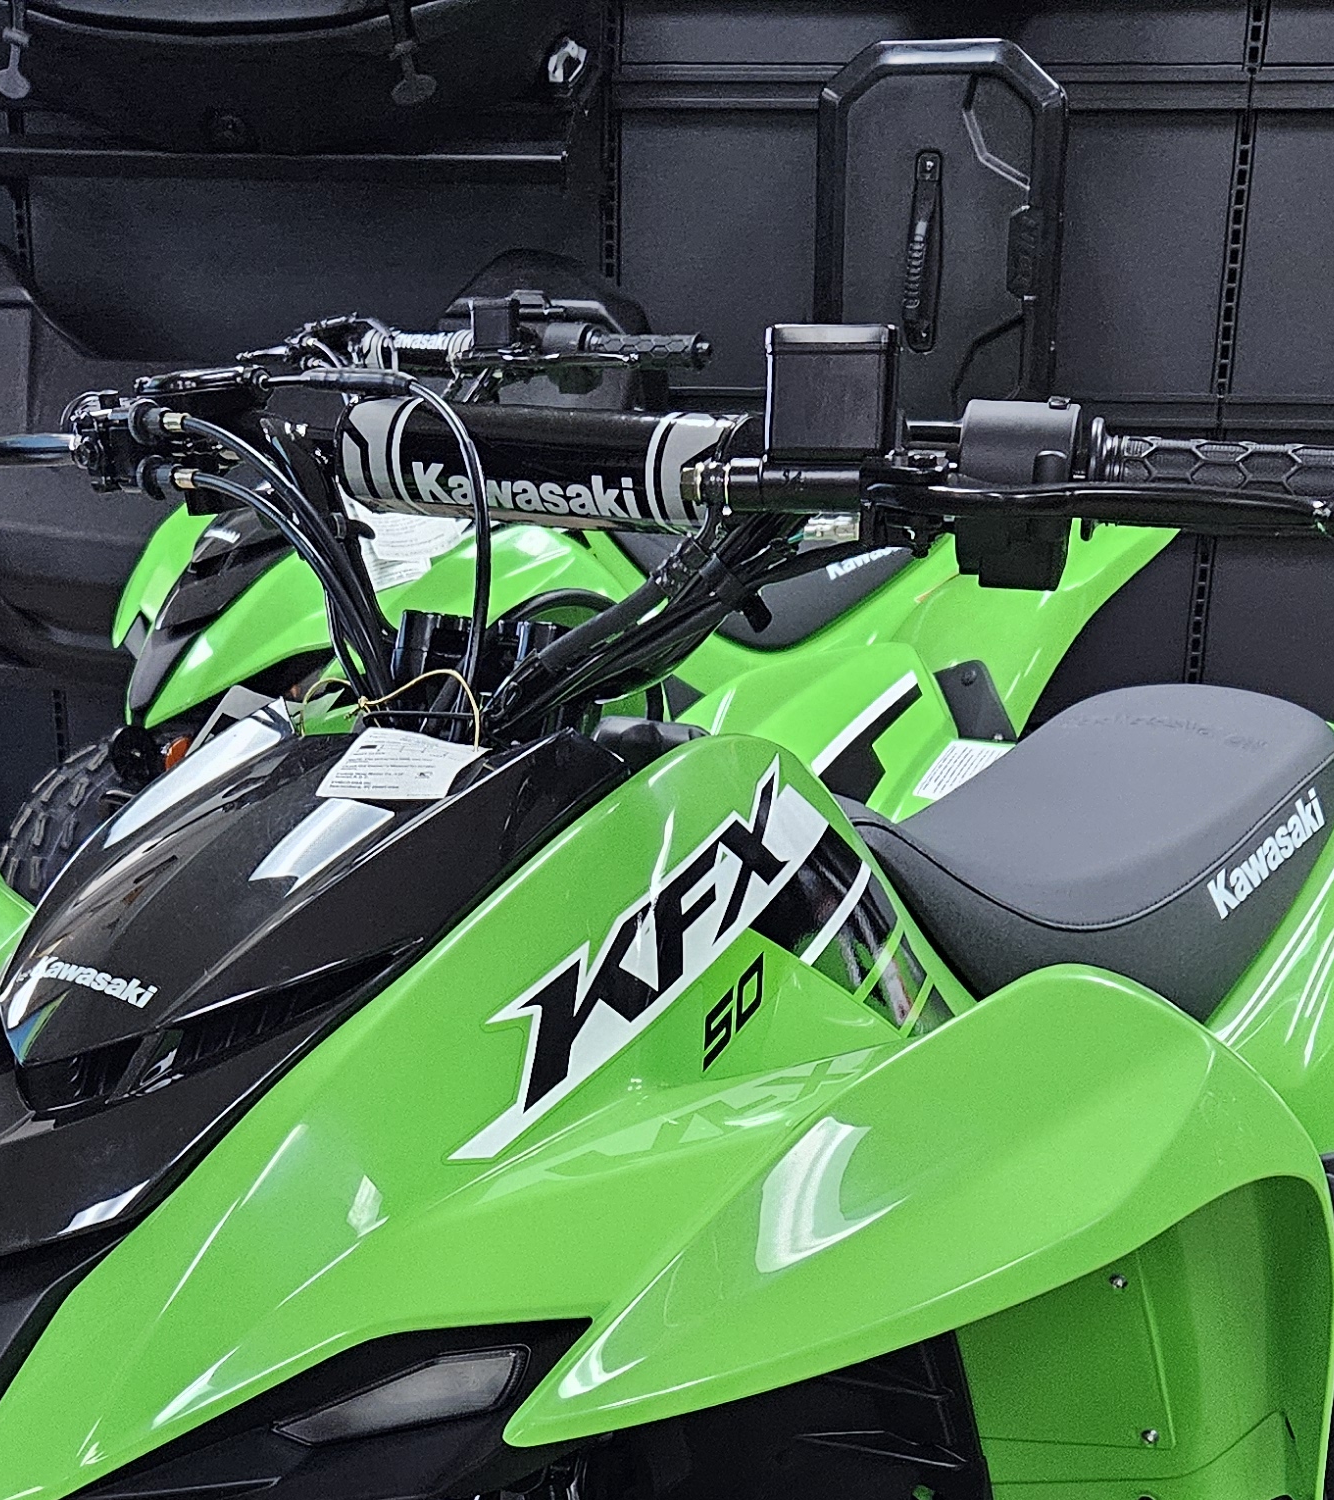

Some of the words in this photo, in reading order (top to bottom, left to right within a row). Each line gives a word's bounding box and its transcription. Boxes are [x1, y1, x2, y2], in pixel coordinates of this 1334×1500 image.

[1206, 787, 1326, 920] Kawasaki
[30, 955, 160, 1009] Kawasaki
[518, 770, 789, 1114] KFX
[702, 951, 765, 1073] 50
